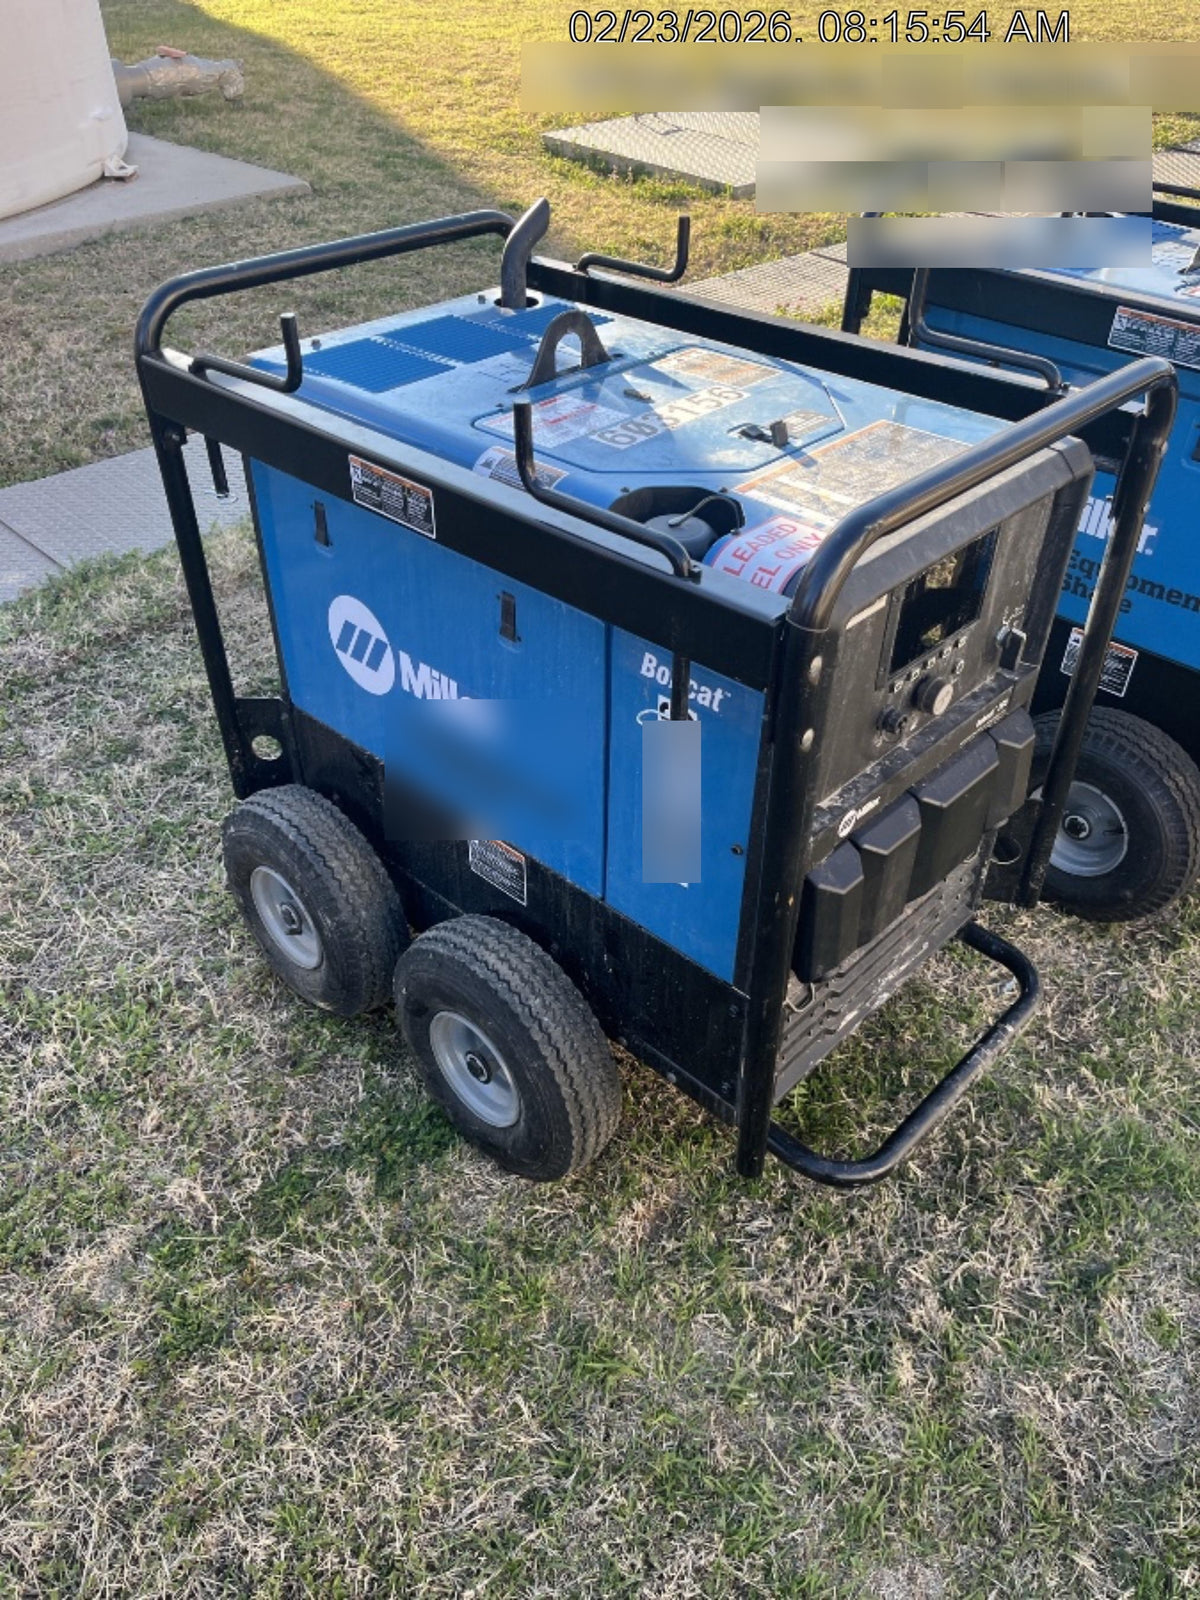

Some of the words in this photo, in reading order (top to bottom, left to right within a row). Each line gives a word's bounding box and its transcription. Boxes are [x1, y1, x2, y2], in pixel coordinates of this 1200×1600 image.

[775, 532, 823, 559] ONLY
[399, 650, 472, 700] Mill
[640, 652, 723, 713] Bocat
